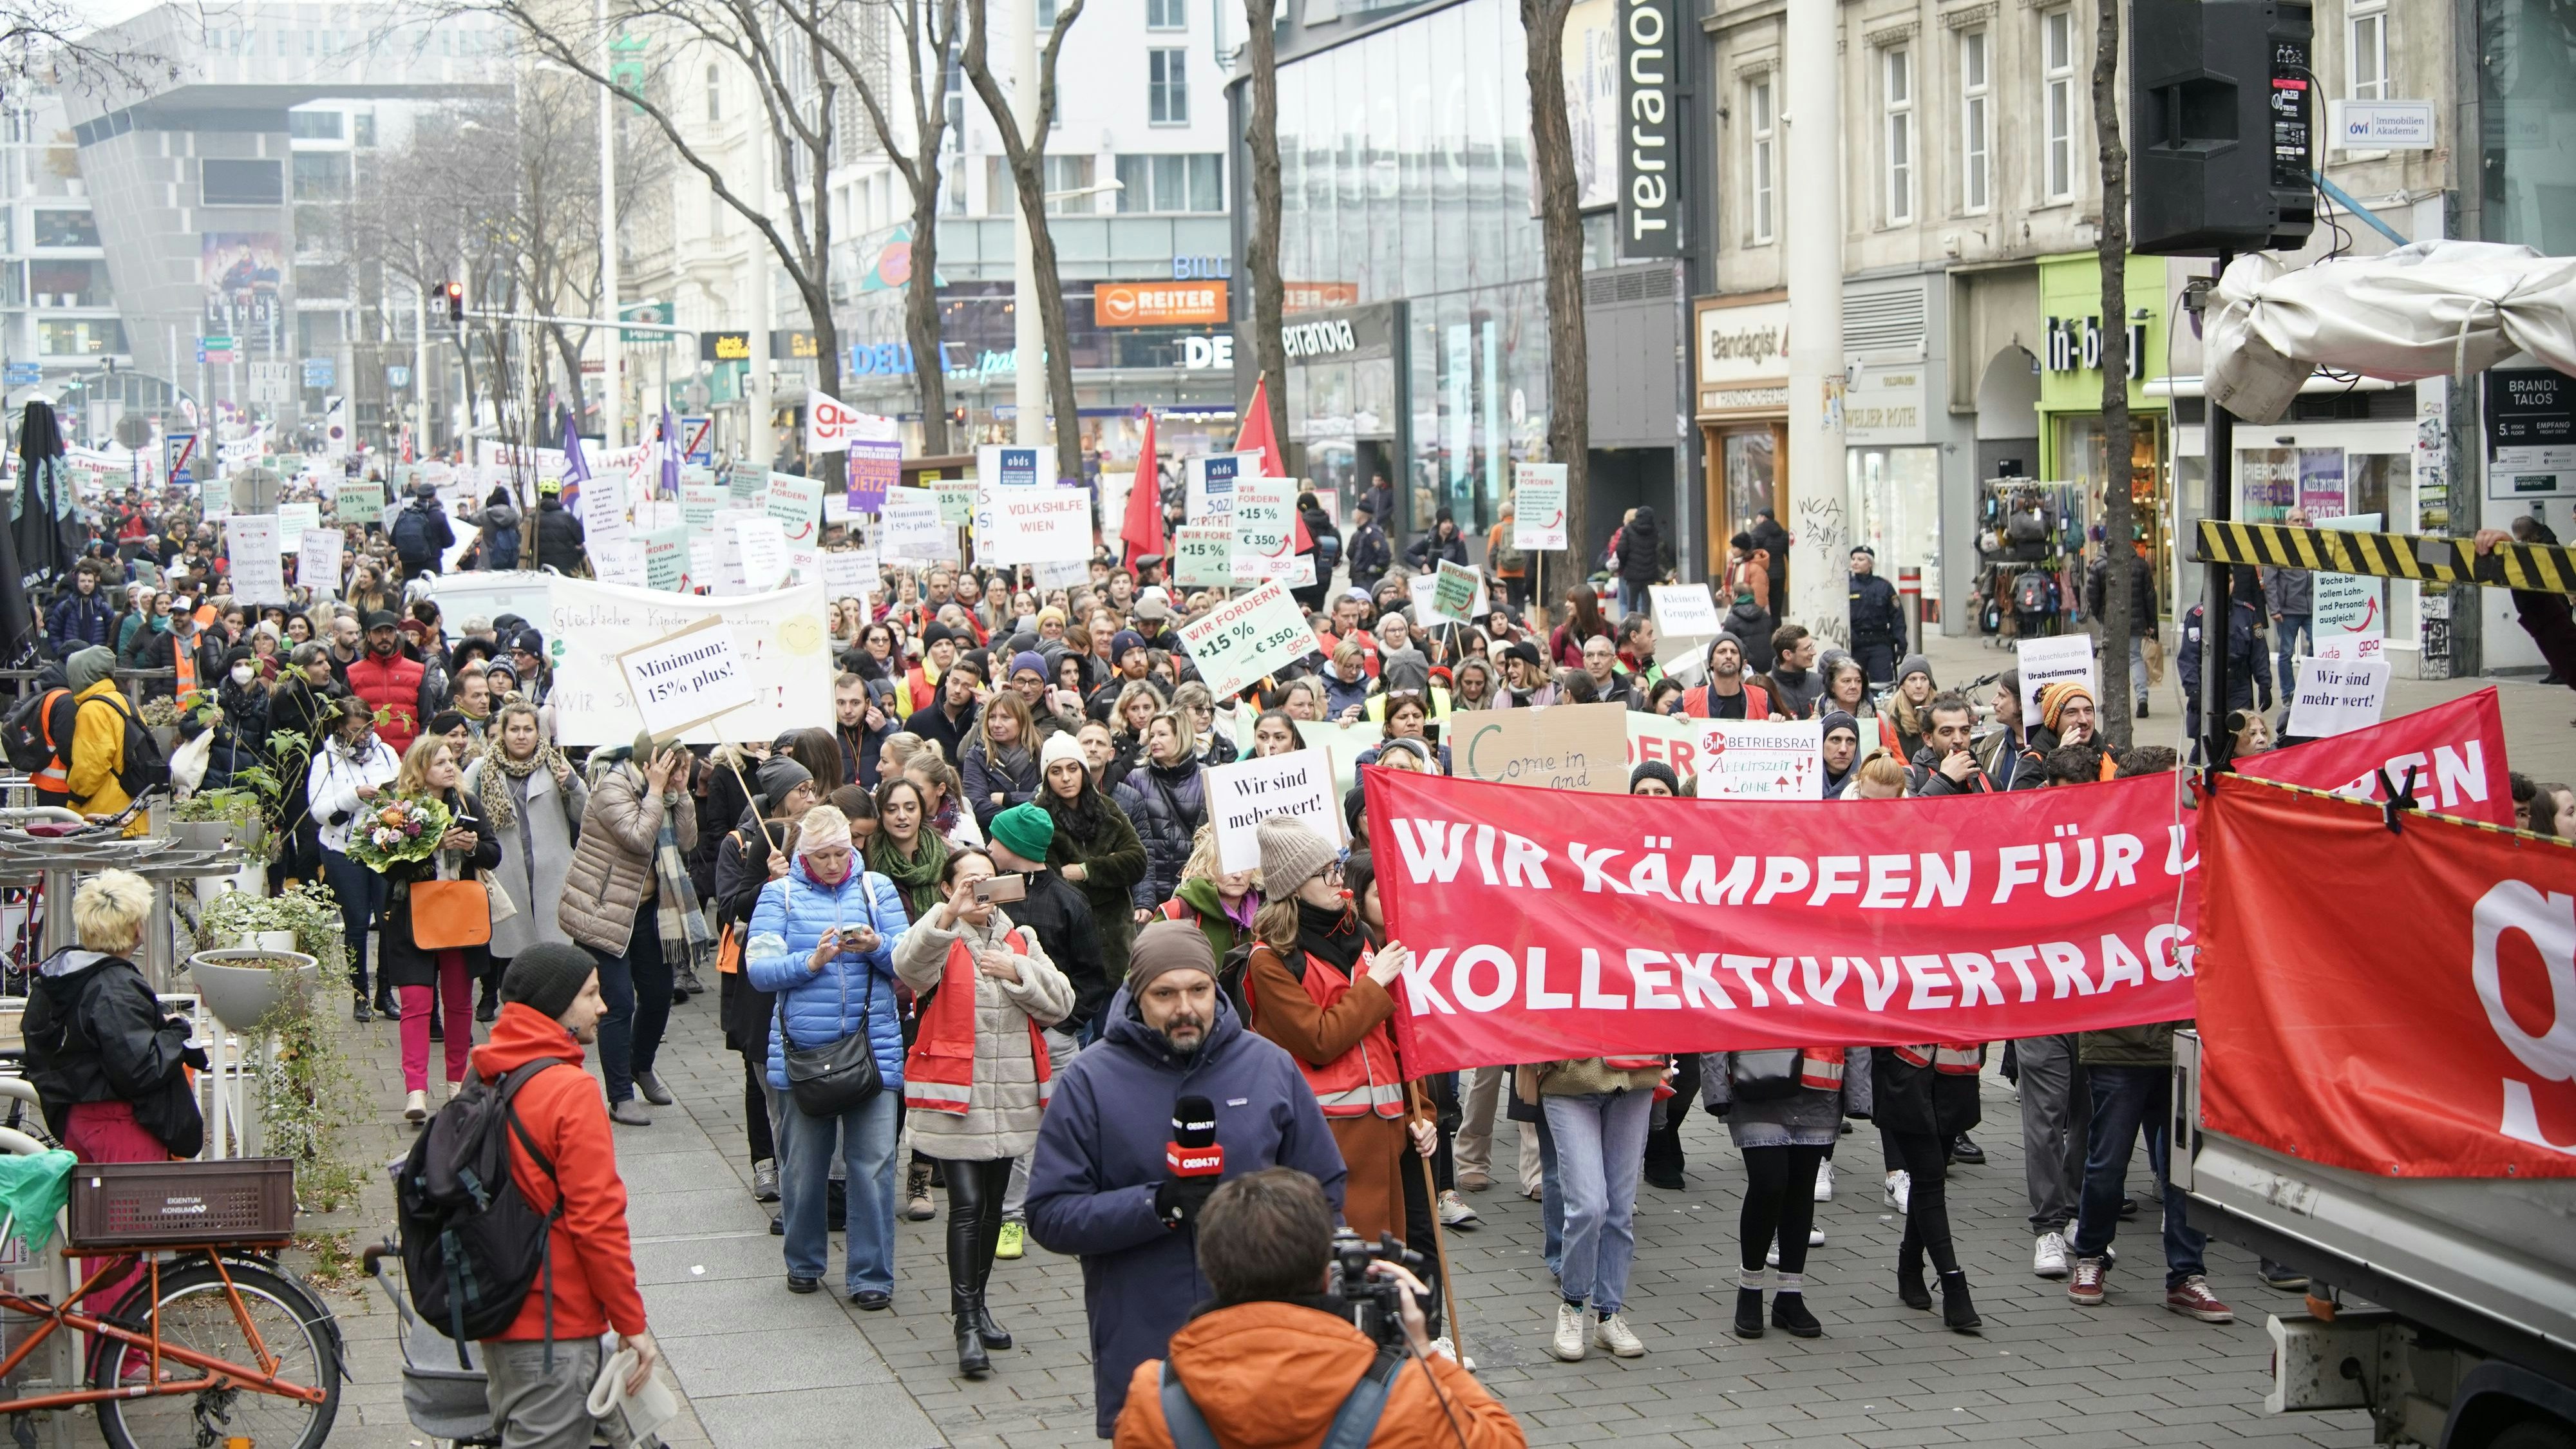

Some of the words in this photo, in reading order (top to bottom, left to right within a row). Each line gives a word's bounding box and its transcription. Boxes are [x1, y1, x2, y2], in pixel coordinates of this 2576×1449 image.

[1629, 0, 1668, 241] Terrano
[2376, 115, 2424, 126] Immobilien
[2376, 126, 2419, 136] Akademie
[1138, 290, 1216, 308] REITER
[1712, 324, 1777, 365] Bandagist
[2509, 379, 2559, 392] BRANDL
[2514, 393, 2553, 405] TALOS
[2499, 423, 2508, 436] 5.
[2537, 421, 2570, 430] EMPFANG
[1008, 456, 1029, 466] obds
[1212, 464, 1231, 475] obds
[773, 480, 788, 488] WIR
[2304, 478, 2318, 491] ALLES
[2327, 478, 2344, 492] STORE
[772, 489, 808, 501] FORDERN
[888, 509, 936, 519] Minimum:
[1009, 500, 1083, 516] VOLKSHILFE
[1238, 509, 1260, 519] +15
[1264, 508, 1278, 519] %
[2305, 506, 2344, 523] GRATIS
[914, 520, 936, 531] plus!
[1020, 520, 1054, 532] WIEN
[1182, 531, 1200, 540] WIR
[1244, 535, 1251, 545] €
[1255, 535, 1283, 547] 350,-
[1181, 545, 1205, 555] +15
[1210, 545, 1224, 556] %
[794, 554, 811, 565] gpa
[1235, 563, 1253, 572] vida
[1270, 560, 1291, 573] gpa
[2320, 576, 2342, 585] Woche
[2345, 574, 2356, 584] bei
[1662, 594, 1702, 603] Kleinere
[2319, 589, 2342, 598] vollem
[2344, 587, 2363, 596] Lohn-
[2319, 603, 2333, 611] und
[2334, 600, 2367, 610] Personal-
[647, 608, 690, 627] Kinder
[1186, 623, 1214, 641] WIR
[1216, 585, 1281, 627] FORDERN
[1664, 607, 1710, 620] Gruppen!
[2319, 613, 2356, 625] ausgleich!
[1198, 634, 1231, 659] +15
[1233, 621, 1255, 639] %
[1256, 642, 1267, 654] €
[1267, 627, 1303, 648] 350,-
[1287, 634, 1312, 656] gpa
[2038, 650, 2069, 661] Abschluss
[2070, 649, 2088, 658] ohne:
[2359, 639, 2380, 658] gpa
[636, 639, 728, 681] Minimum:
[1240, 654, 1256, 665] mind.
[2028, 668, 2087, 680] Urabstimmung
[2316, 670, 2342, 685] Wir
[2345, 673, 2371, 686] sind
[647, 679, 688, 704] 15%
[692, 661, 735, 693] plus!
[1217, 676, 1242, 695] vida
[2302, 692, 2339, 706] mehr
[2342, 694, 2375, 708] wert!
[1729, 737, 1816, 749] BETRIEBSRAT
[1566, 751, 1586, 769] in
[1233, 777, 1267, 799] Wir
[1273, 768, 1308, 791] sind
[1551, 771, 1591, 791] and
[1229, 807, 1273, 829] mehr
[1277, 793, 1322, 817] wert!
[1391, 817, 1548, 888] WIR
[1567, 835, 1972, 909] KÄMPFEN
[1991, 822, 2143, 904] FÜR
[1406, 922, 2196, 1018] KOLLEKTIVVERTRAG
